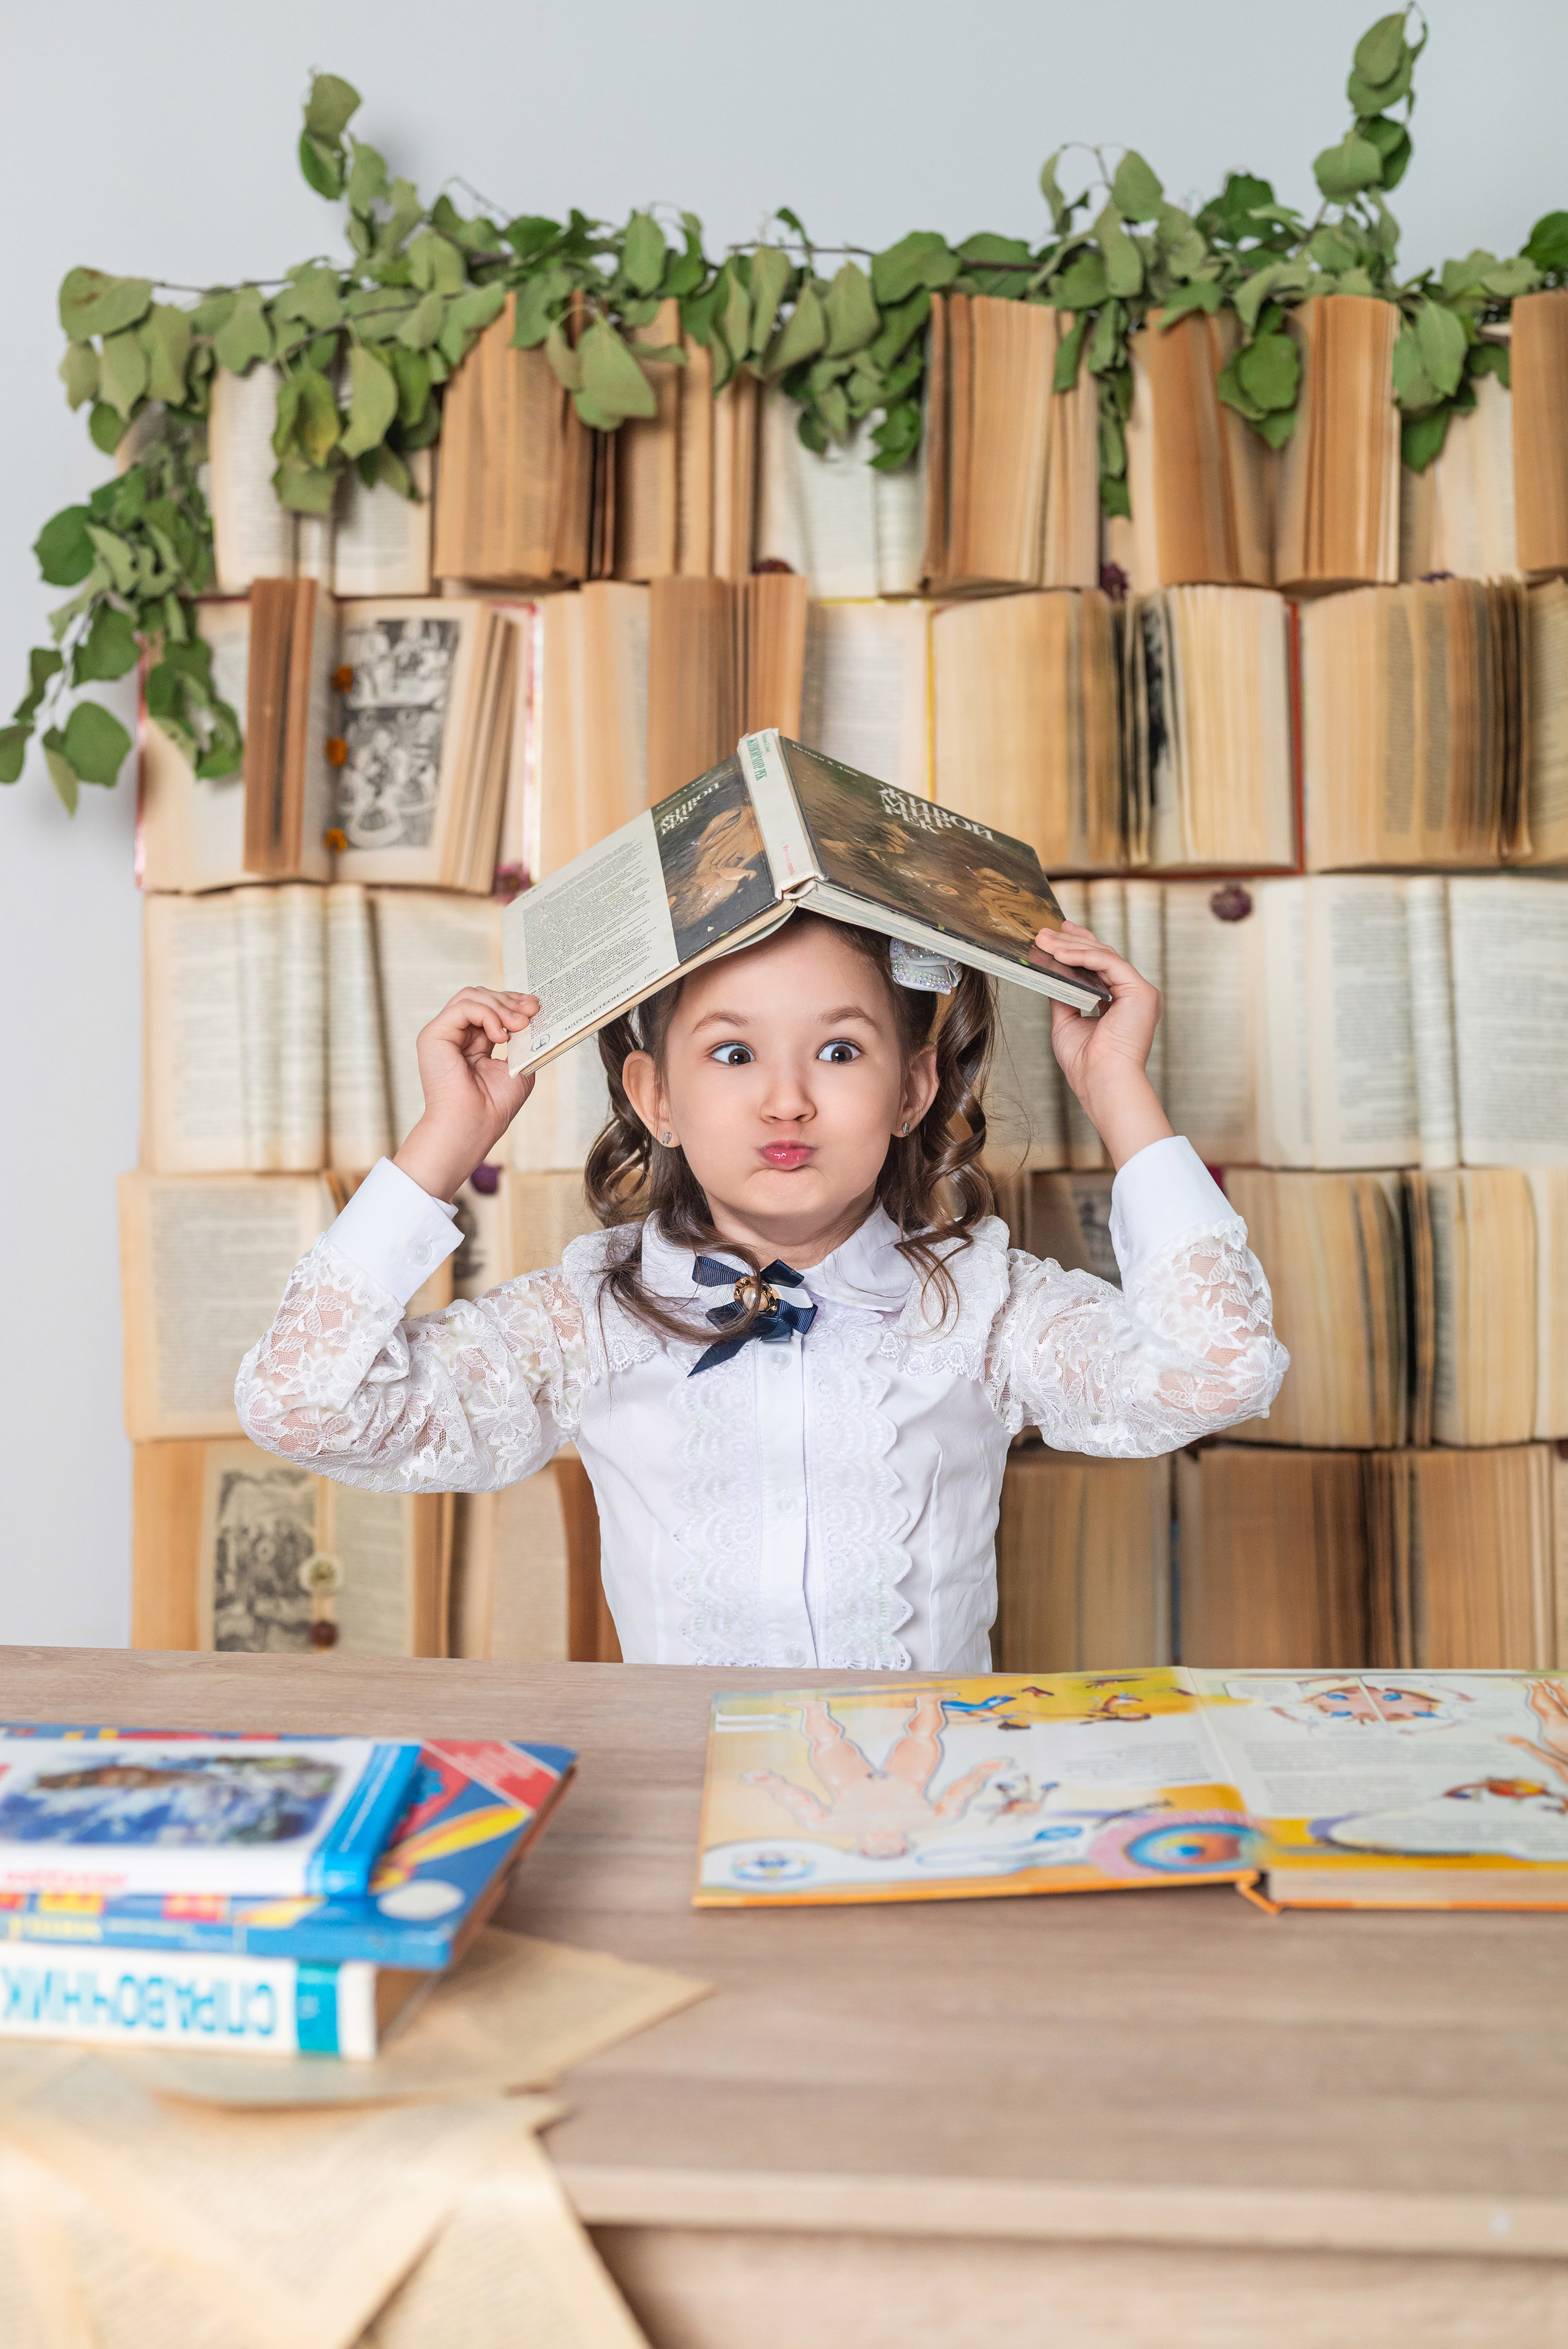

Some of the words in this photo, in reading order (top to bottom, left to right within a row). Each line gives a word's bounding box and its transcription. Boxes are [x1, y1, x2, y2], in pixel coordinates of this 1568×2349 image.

[746, 736, 763, 758] ЖИВОЙ
[752, 755, 765, 770] МИР
[754, 768, 767, 781] РЕК
[660, 801, 698, 826] МИР
[661, 782, 719, 822] ЖИВОЙ
[878, 782, 994, 841] ЖИВОЙ
[881, 794, 952, 829] МИР
[662, 816, 690, 835] РЕК
[883, 804, 940, 836] РЕК
[1, 1968, 277, 2036] СПРАВОЧНИК
